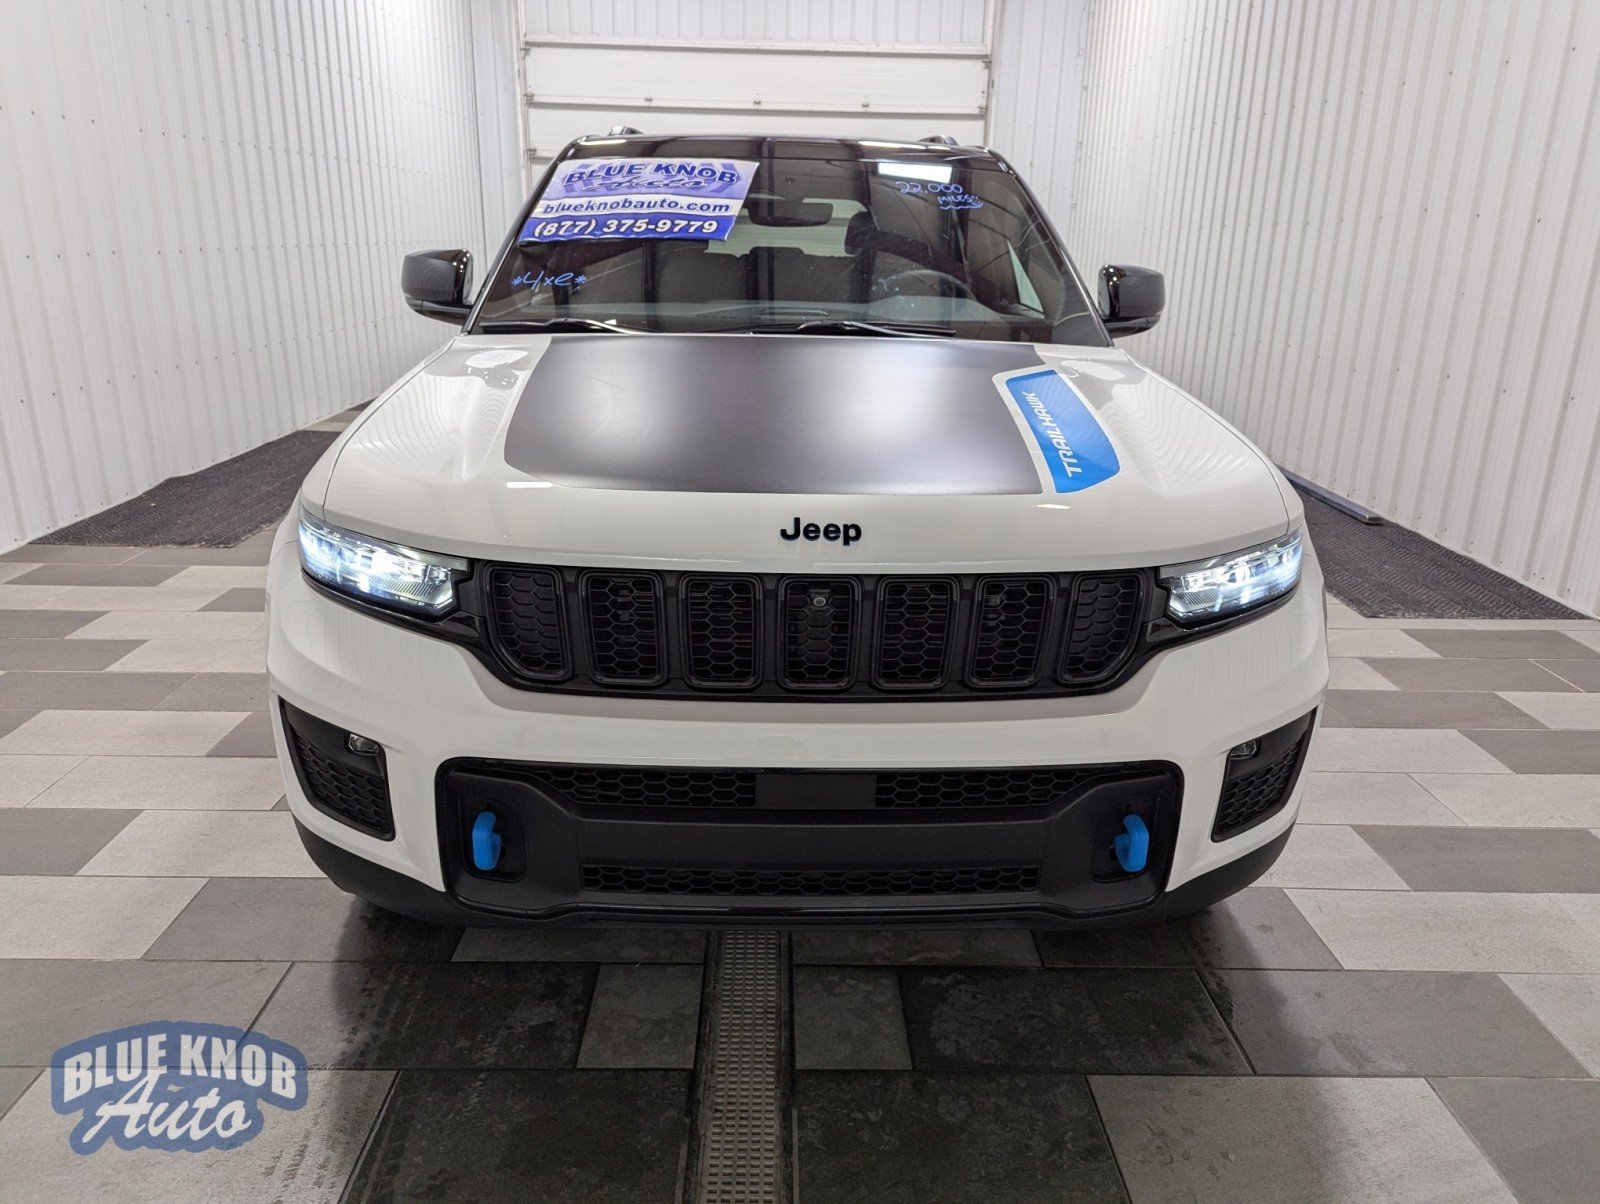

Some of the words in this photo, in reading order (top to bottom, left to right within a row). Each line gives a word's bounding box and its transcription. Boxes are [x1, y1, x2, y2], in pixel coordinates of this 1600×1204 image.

[566, 162, 643, 185] BLUE
[653, 162, 739, 186] KNOB
[542, 197, 731, 216] blueknobauto.com
[533, 219, 597, 238] (877)
[602, 218, 719, 234] 375-9779
[1021, 391, 1082, 478] TRAILHAWK
[780, 517, 862, 546] Jeep
